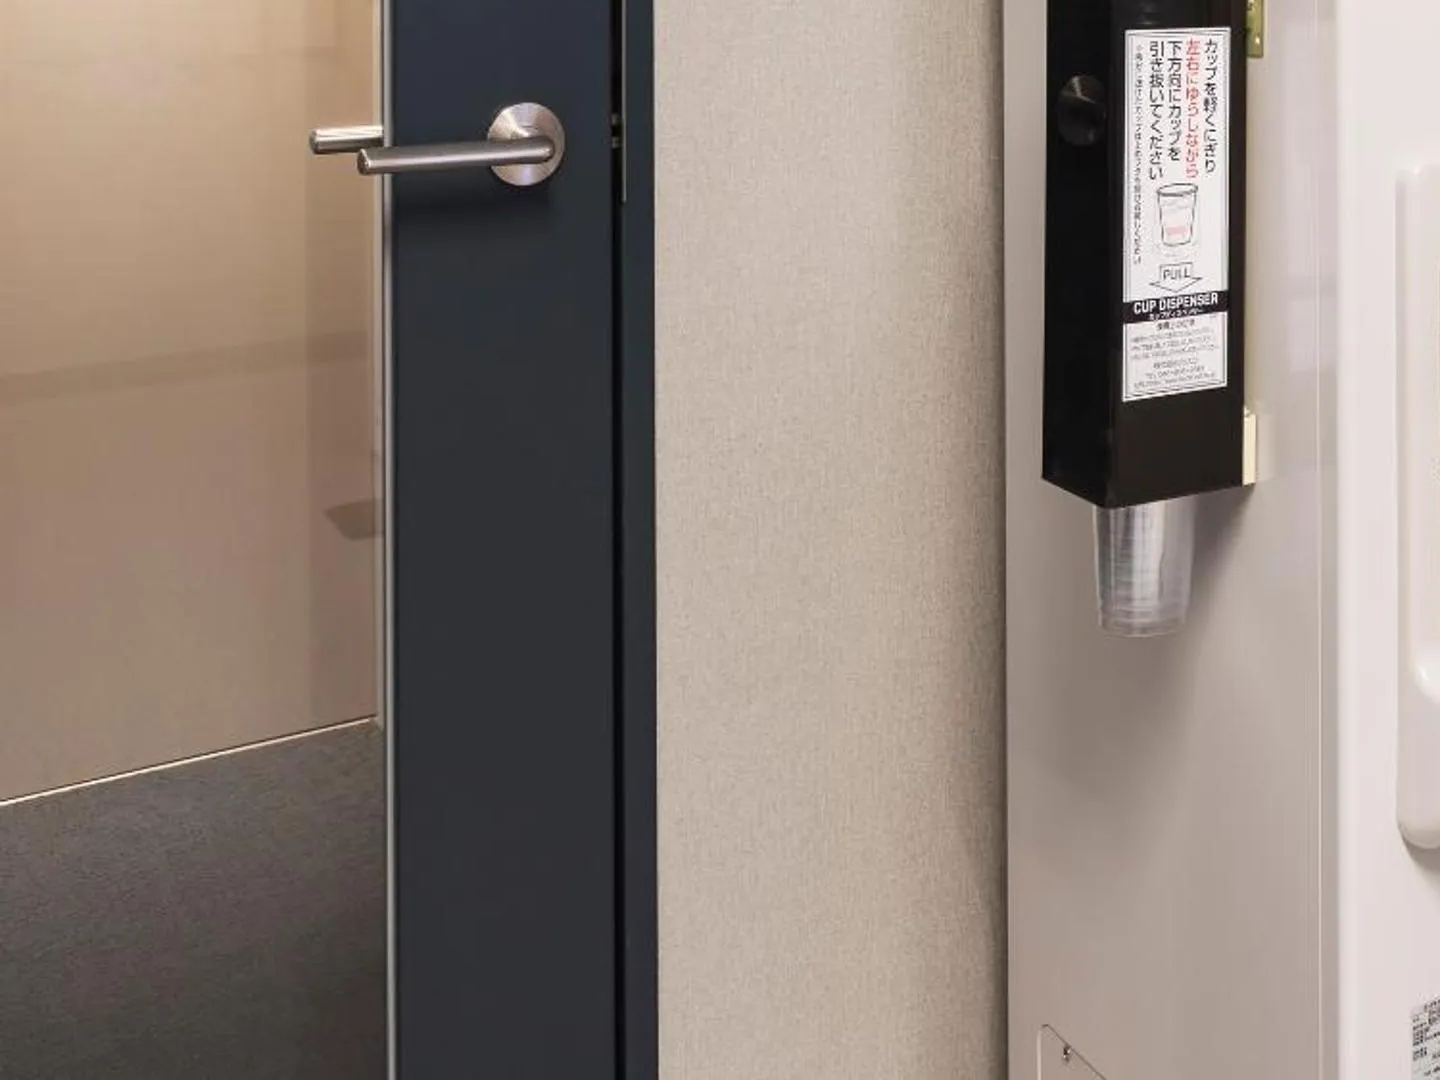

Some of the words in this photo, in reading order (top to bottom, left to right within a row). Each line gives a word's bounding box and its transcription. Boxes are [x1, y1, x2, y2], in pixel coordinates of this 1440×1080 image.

[1149, 40, 1164, 181] 引き抜いてください
[1167, 40, 1182, 162] 下方向にカップを
[1186, 38, 1200, 179] 左右にゆらしながら
[1133, 300, 1157, 315] CUP
[1159, 292, 1219, 312] DISPENSER
[1163, 267, 1191, 280] PULL
